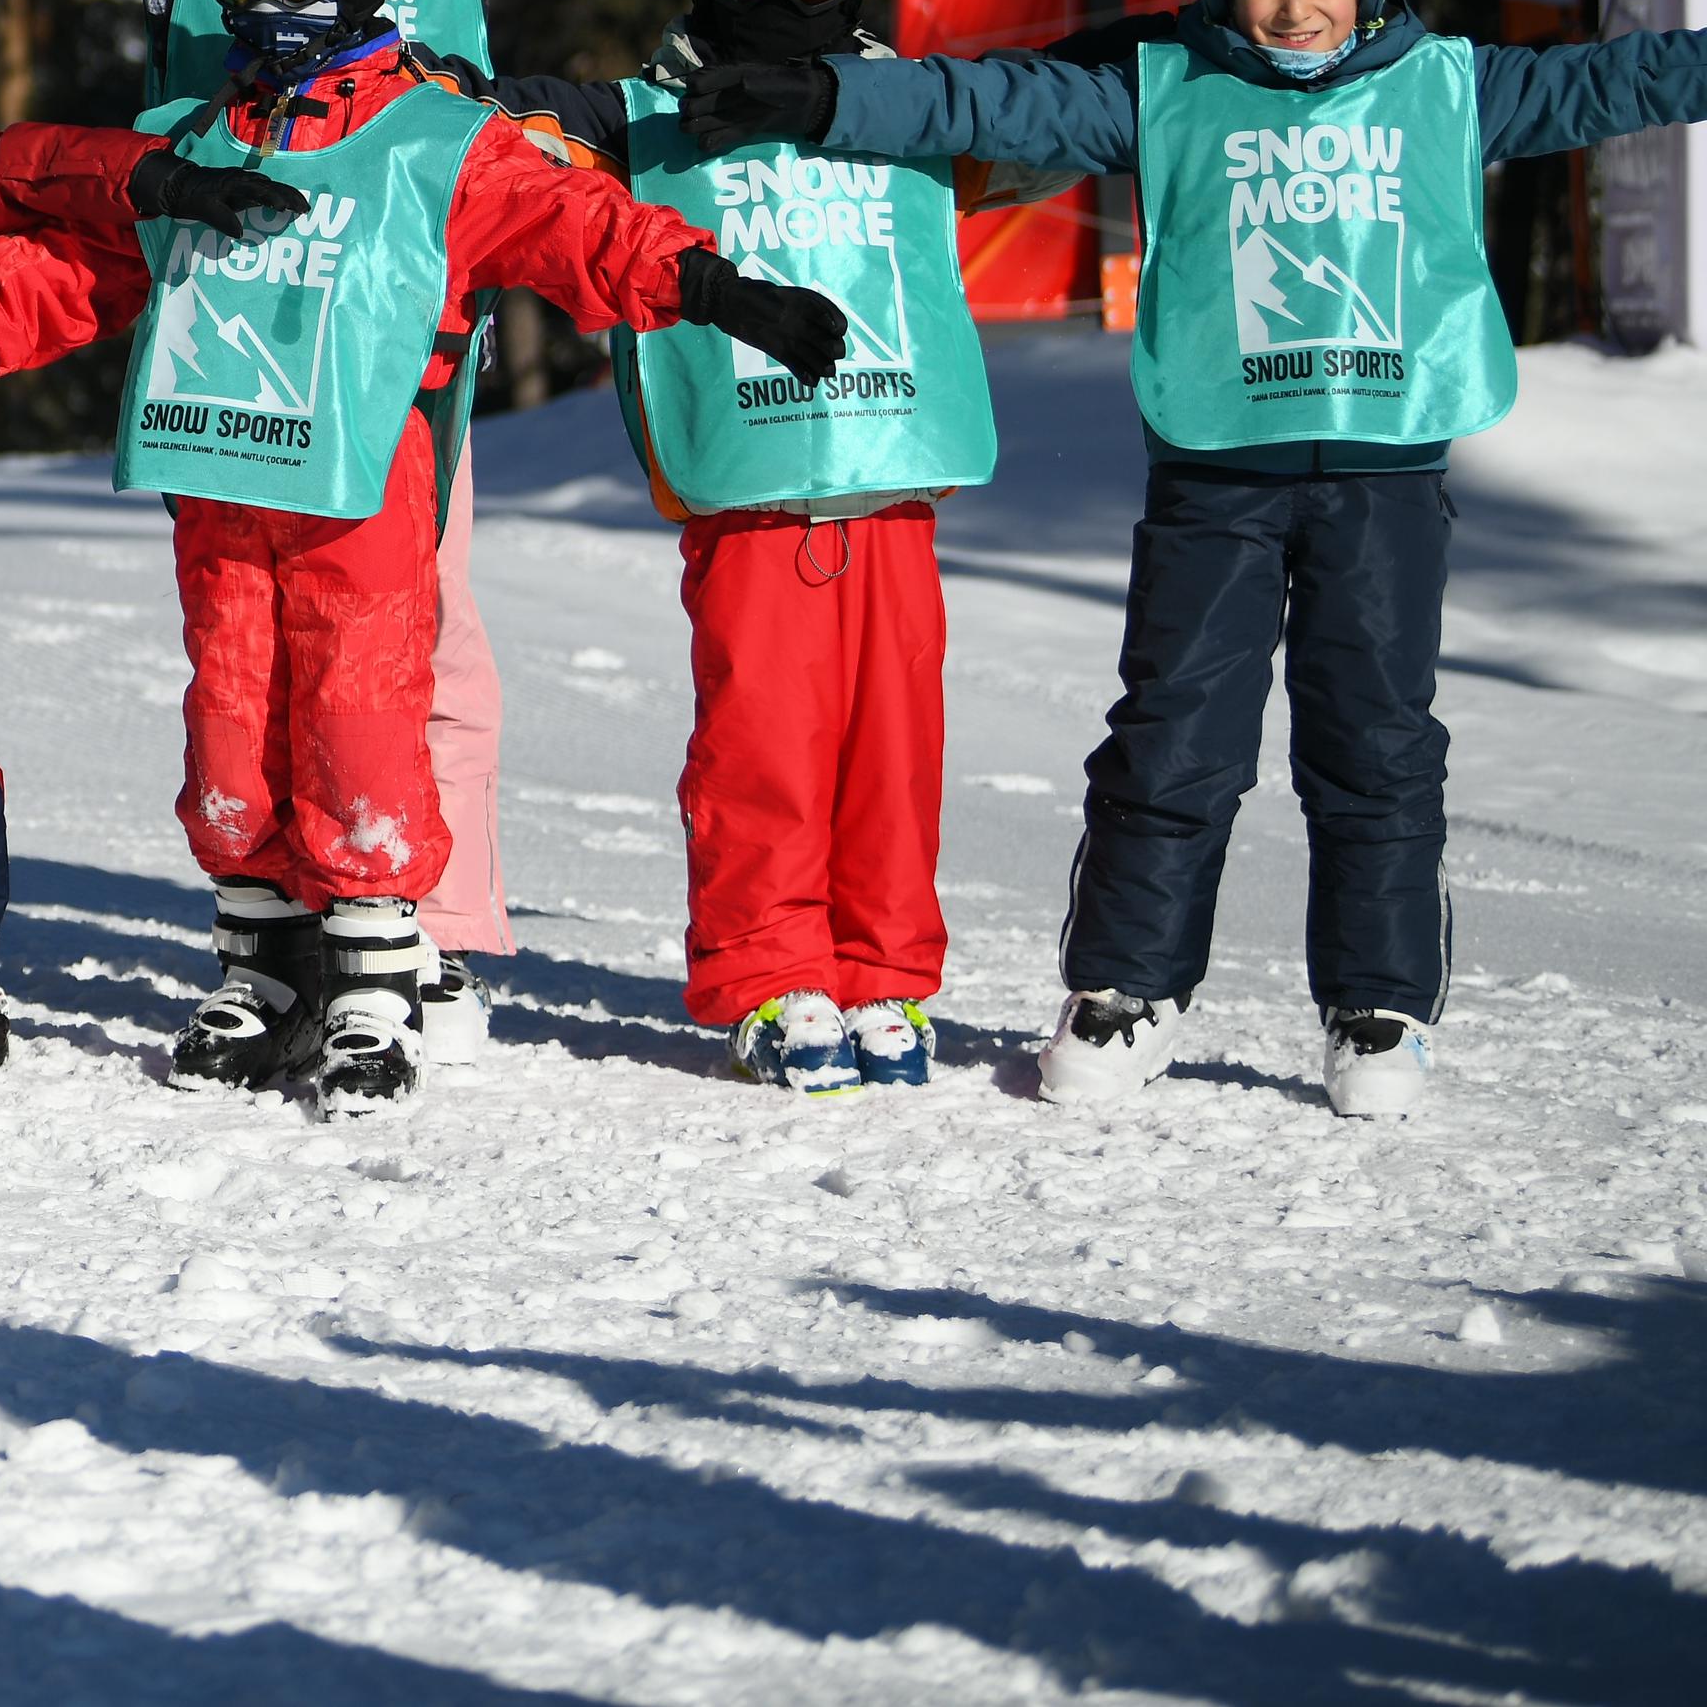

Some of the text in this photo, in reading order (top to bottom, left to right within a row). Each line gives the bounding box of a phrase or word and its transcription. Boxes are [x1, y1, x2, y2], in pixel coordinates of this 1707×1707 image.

[1224, 124, 1403, 179] SNOW
[714, 154, 890, 206] SNOW
[1229, 171, 1403, 227] MORE
[720, 199, 894, 253] MORE
[170, 229, 343, 287] MORE
[1242, 349, 1405, 385] SNOW SPORTS
[737, 372, 916, 409] SNOW SPORTS
[1252, 393, 1268, 402] DAHA
[1331, 388, 1351, 396] DAHA
[140, 403, 312, 449] SNOW SPORTS
[748, 417, 768, 427] DAHA
[834, 410, 853, 418] DAHA
[854, 409, 877, 417] MUTLU
[142, 440, 159, 449] DAHA
[219, 449, 238, 458] DAHA
[240, 452, 264, 462] MUTLU
[266, 456, 301, 467] ÇOCUKLAR
